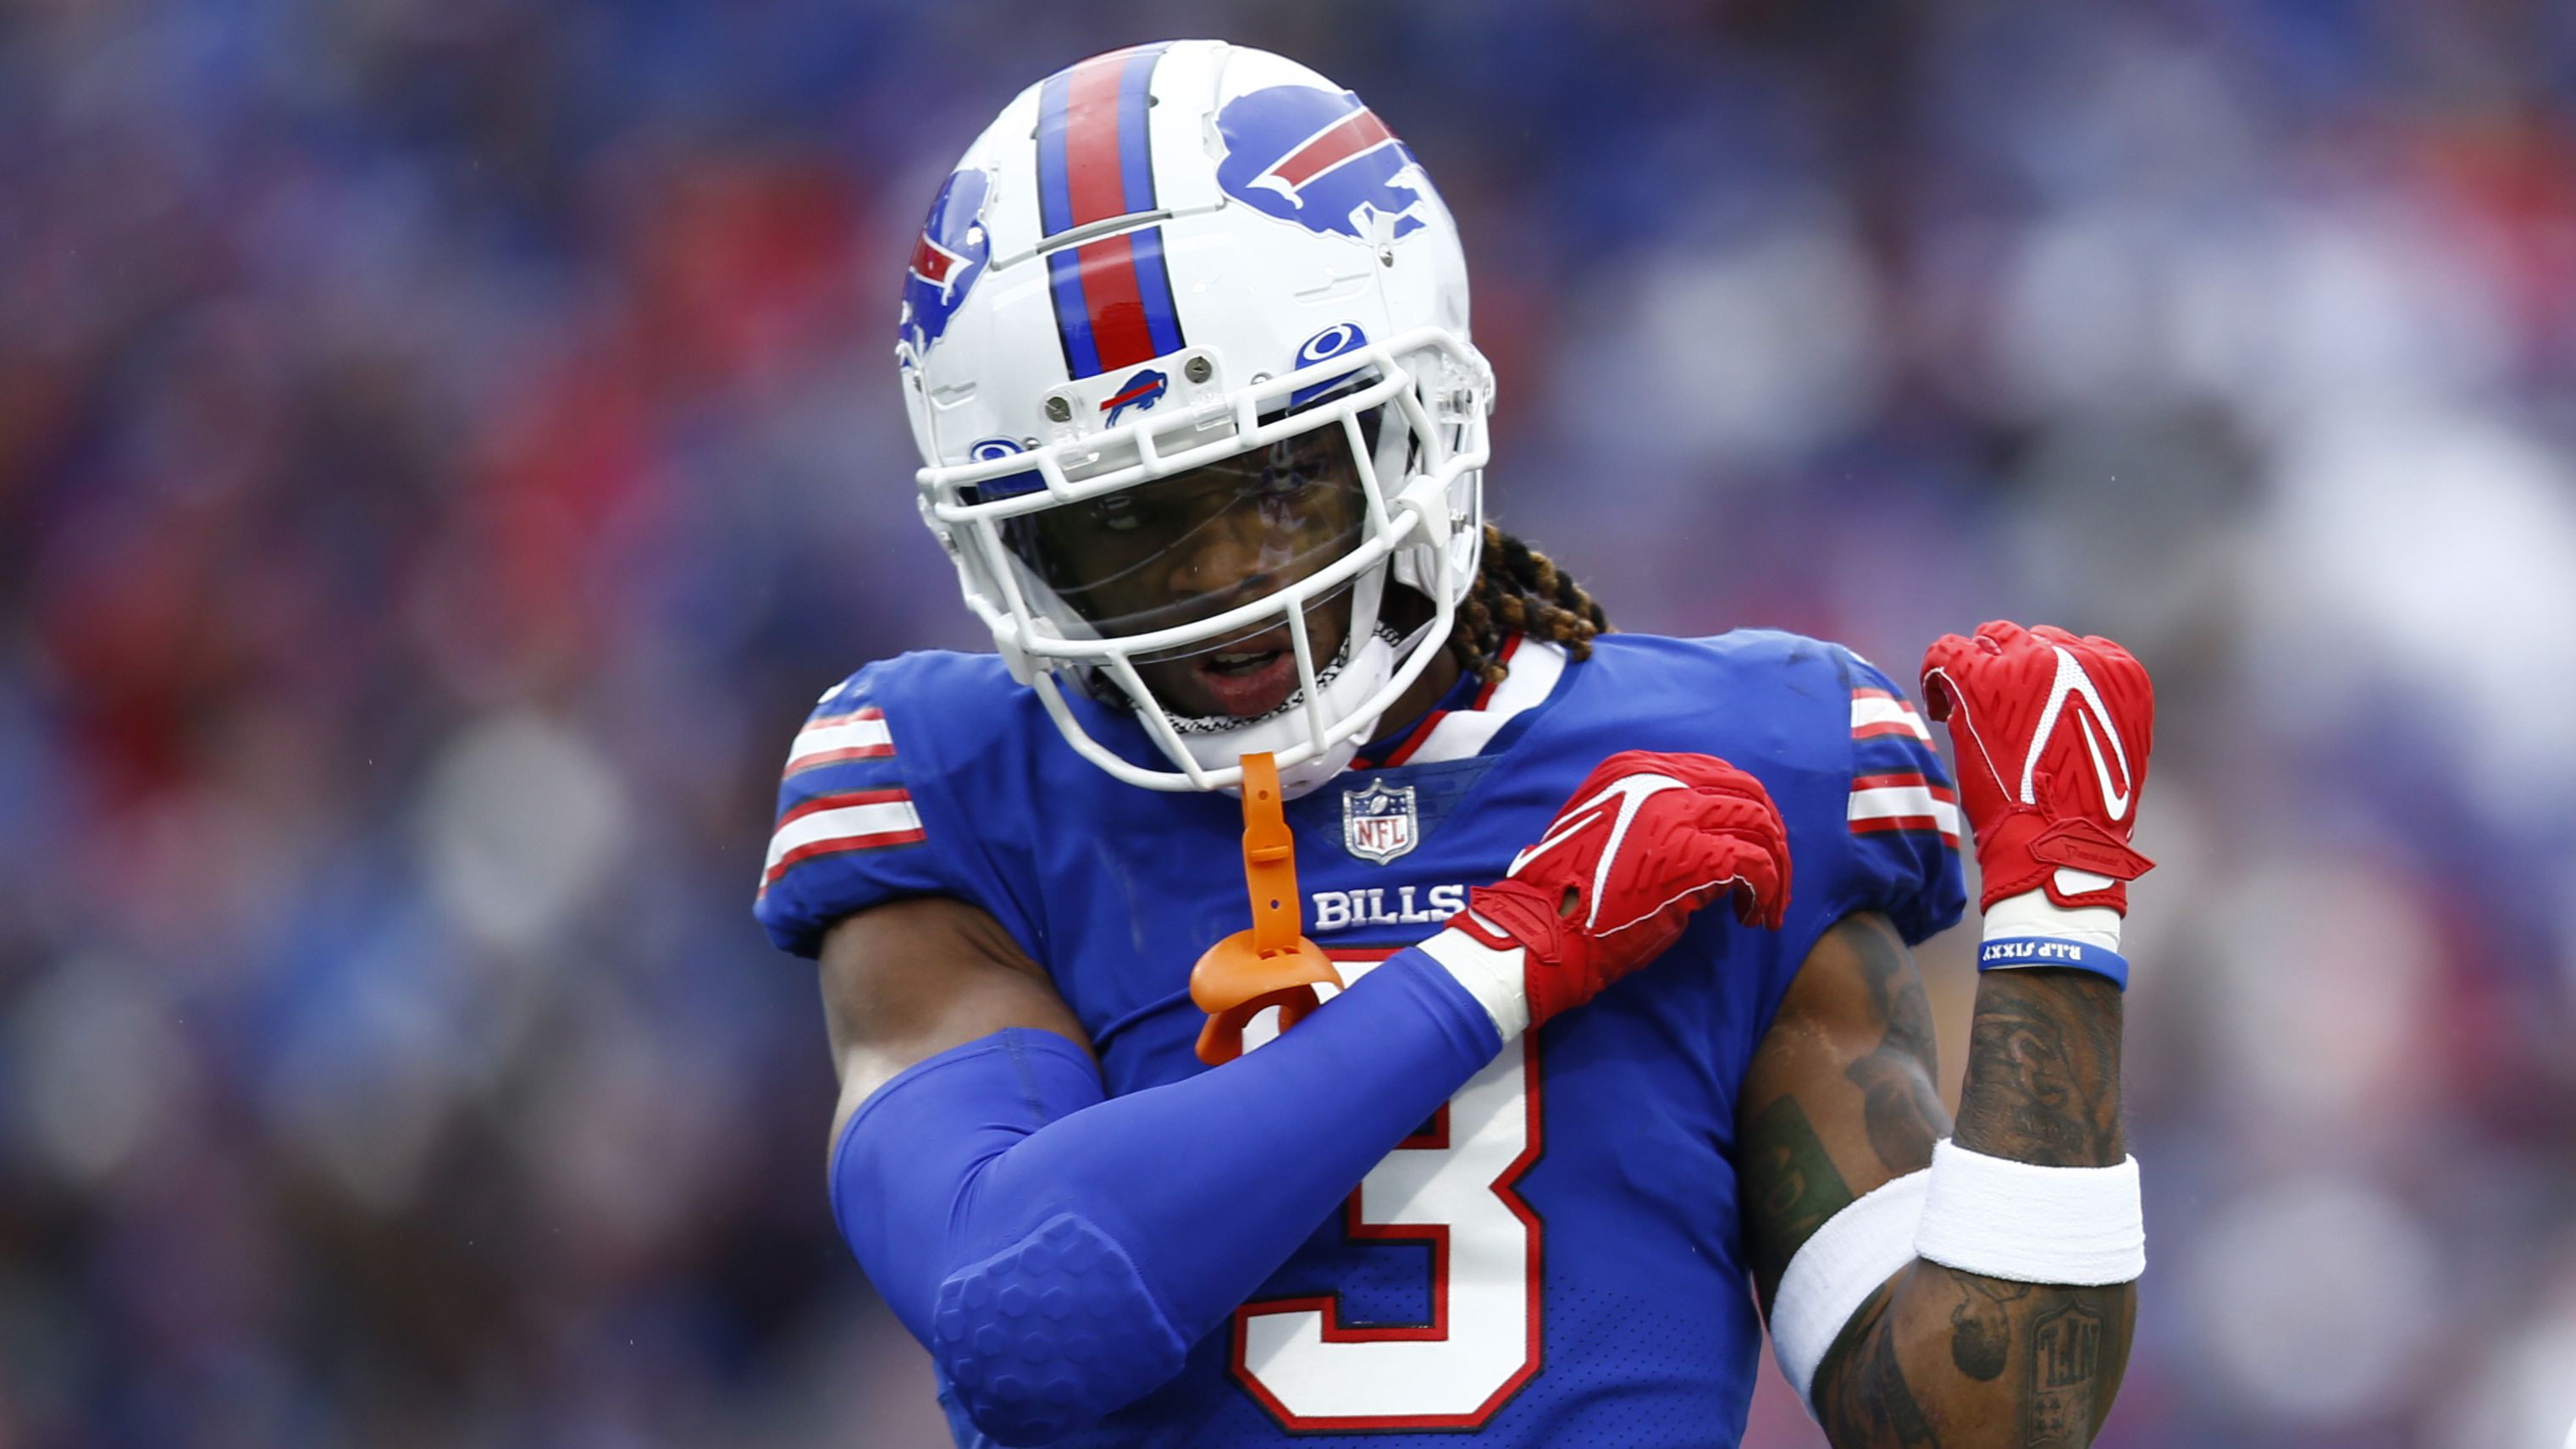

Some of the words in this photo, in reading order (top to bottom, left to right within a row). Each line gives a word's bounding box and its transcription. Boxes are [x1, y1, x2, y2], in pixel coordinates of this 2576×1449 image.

[1357, 818, 1405, 849] NFL
[1312, 884, 1466, 930] BILLS
[1230, 947, 1545, 1435] 3
